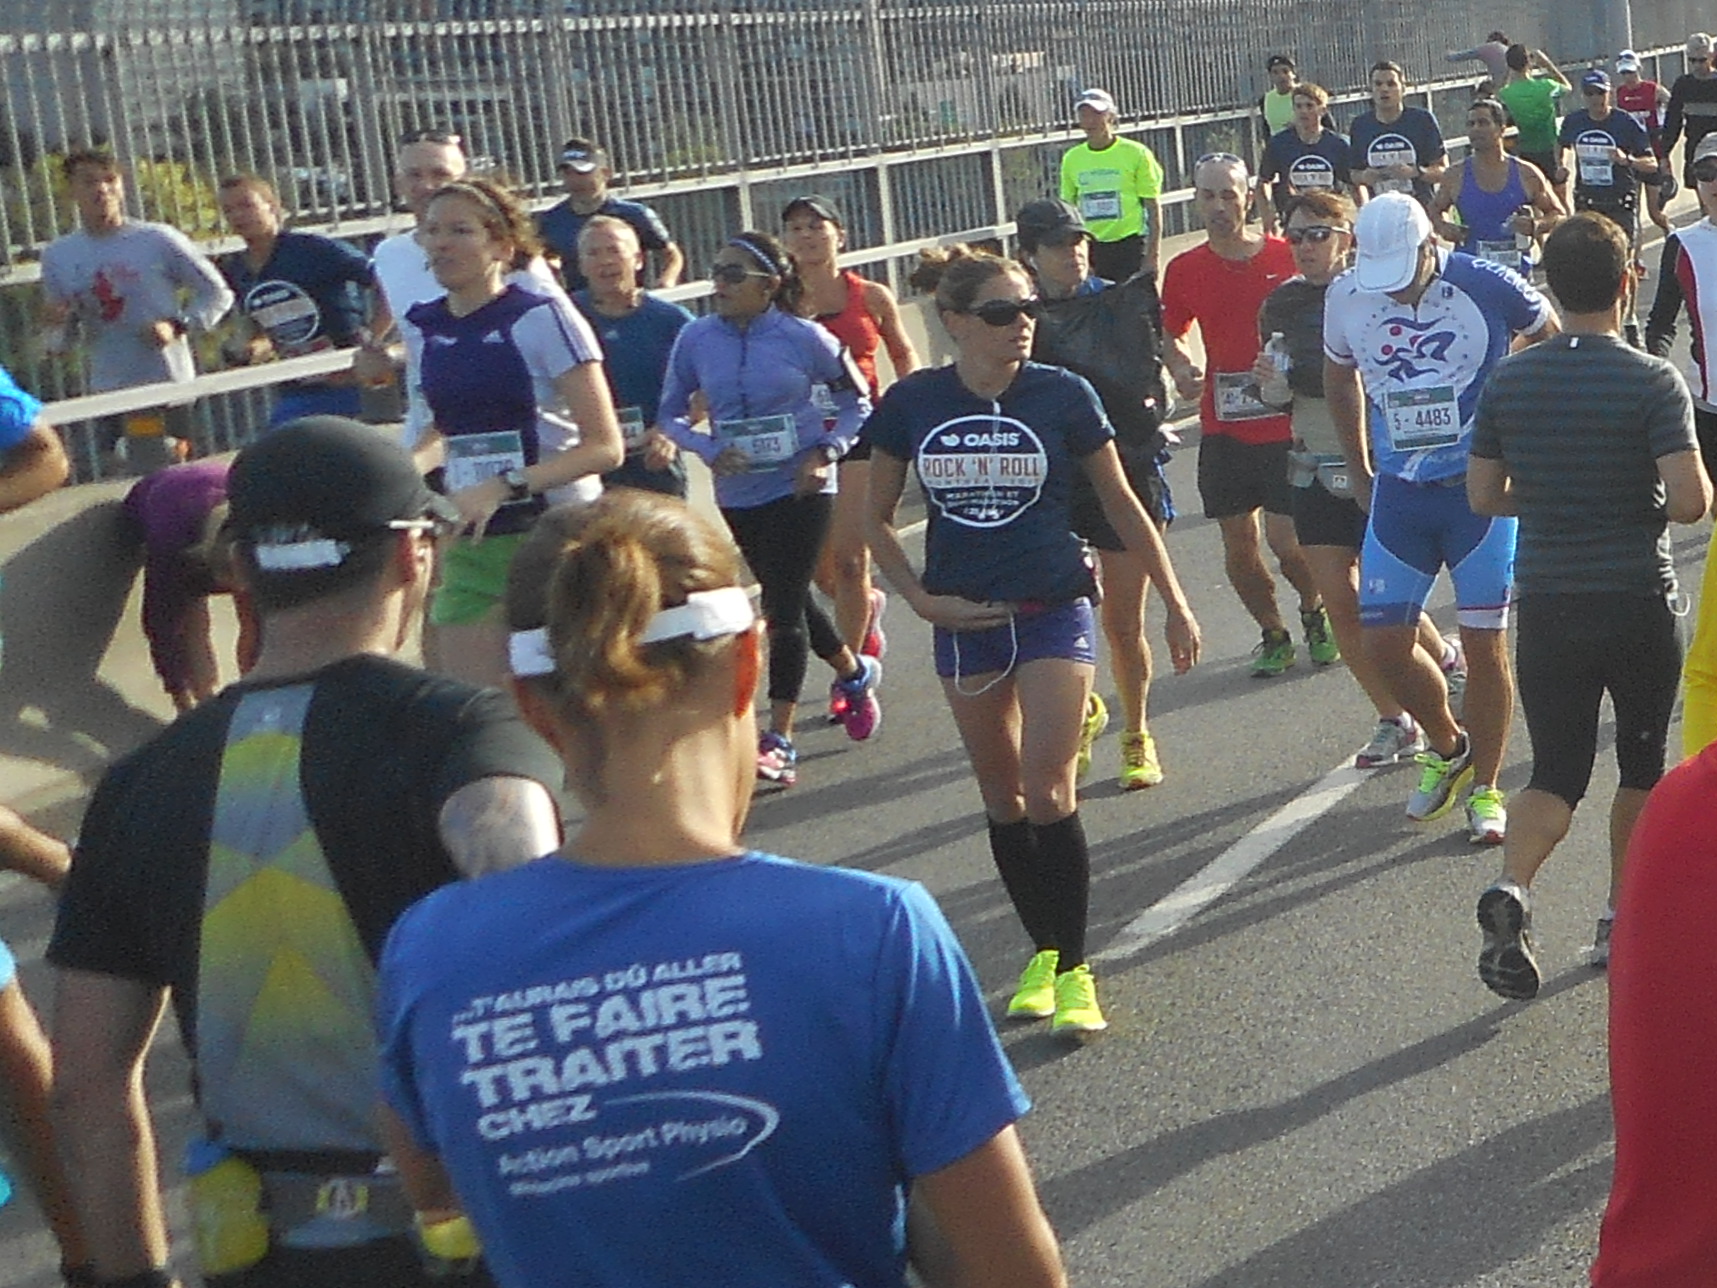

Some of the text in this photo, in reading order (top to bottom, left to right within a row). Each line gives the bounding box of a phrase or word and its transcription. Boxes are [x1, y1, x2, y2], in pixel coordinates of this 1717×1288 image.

[1393, 411, 1402, 431] 5
[1415, 408, 1451, 426] 4483
[963, 432, 1020, 447] OASIS
[923, 457, 966, 478] ROCK
[1000, 456, 1040, 477] ROLL
[652, 951, 741, 983] ALLER
[452, 973, 751, 1063] TE FAIRE
[460, 1019, 763, 1108] TRAITER
[477, 1093, 597, 1142] CHEZ
[583, 1126, 659, 1160] Sport
